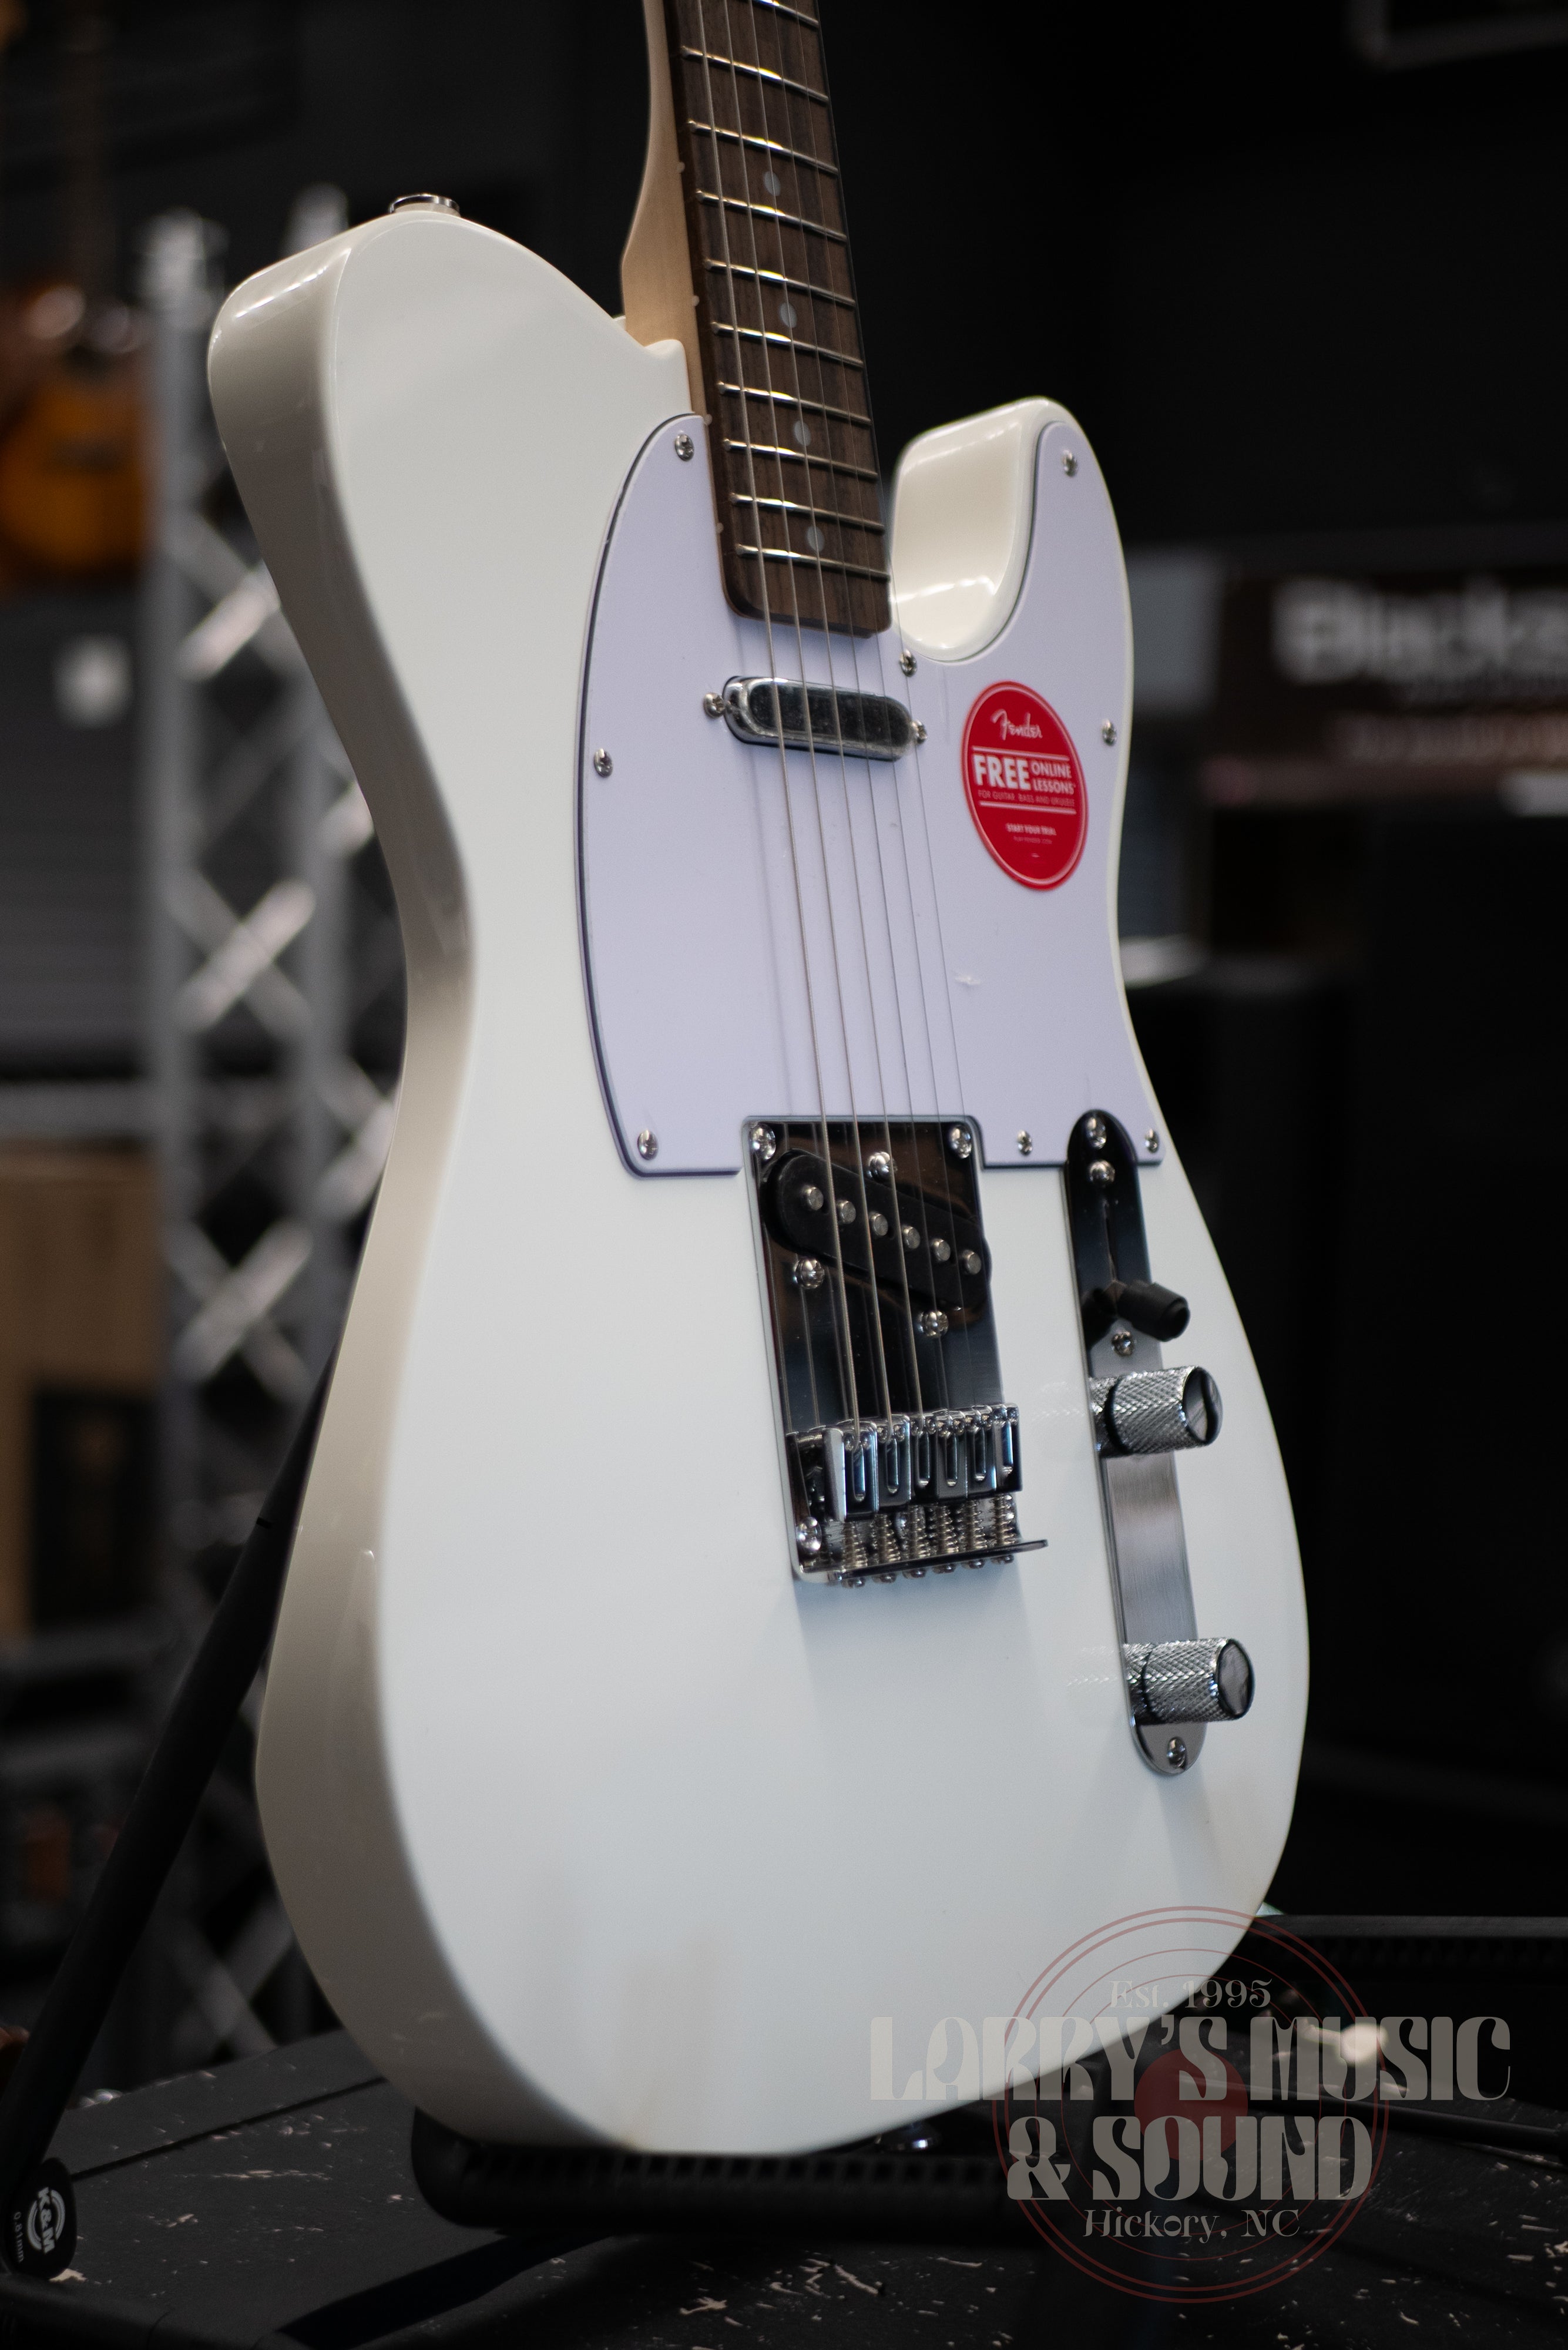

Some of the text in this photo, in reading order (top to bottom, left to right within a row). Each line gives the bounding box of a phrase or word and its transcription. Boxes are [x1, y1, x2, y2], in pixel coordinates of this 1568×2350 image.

[990, 709, 1043, 741] Fender
[973, 754, 1031, 791] FREE
[1032, 761, 1072, 778] ONLINE
[978, 790, 991, 798] FOR
[1018, 793, 1035, 803] BASS
[1035, 795, 1050, 804] AND
[1005, 822, 1023, 833] START
[1024, 824, 1040, 834] YOUR
